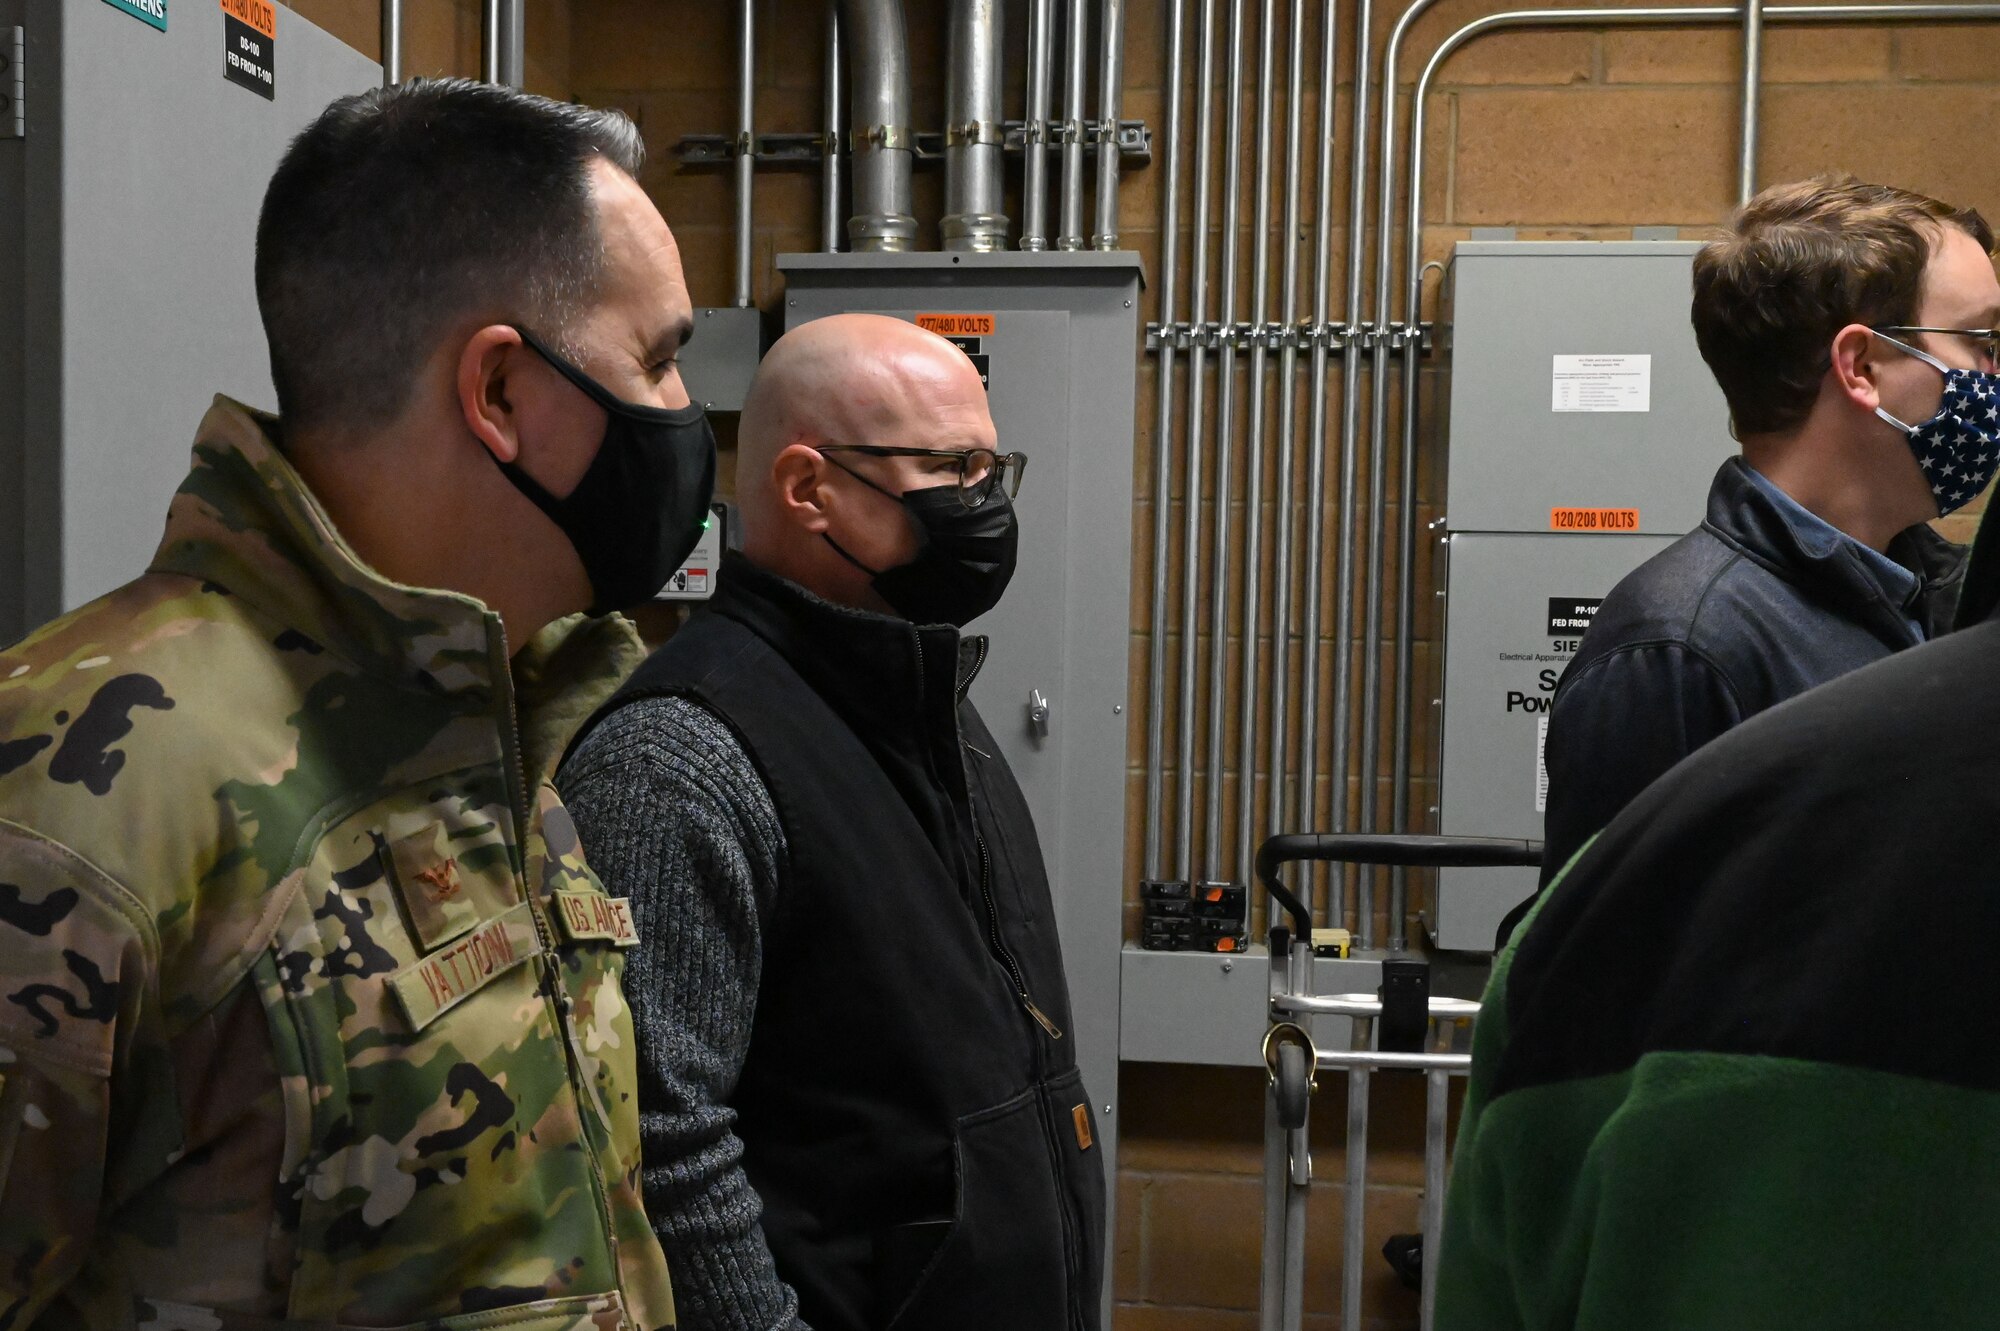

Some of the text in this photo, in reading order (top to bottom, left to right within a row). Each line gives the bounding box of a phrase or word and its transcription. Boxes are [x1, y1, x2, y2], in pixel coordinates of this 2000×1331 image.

[250, 0, 272, 33] VOLTS
[240, 36, 260, 57] DS-100
[228, 51, 272, 85] FED FROM T-100
[920, 318, 990, 333] 277/480 VOLTS
[1554, 511, 1635, 528] 120/208 VOLTS
[1552, 619, 1590, 628] FED FROM
[1499, 653, 1533, 661] Electrical
